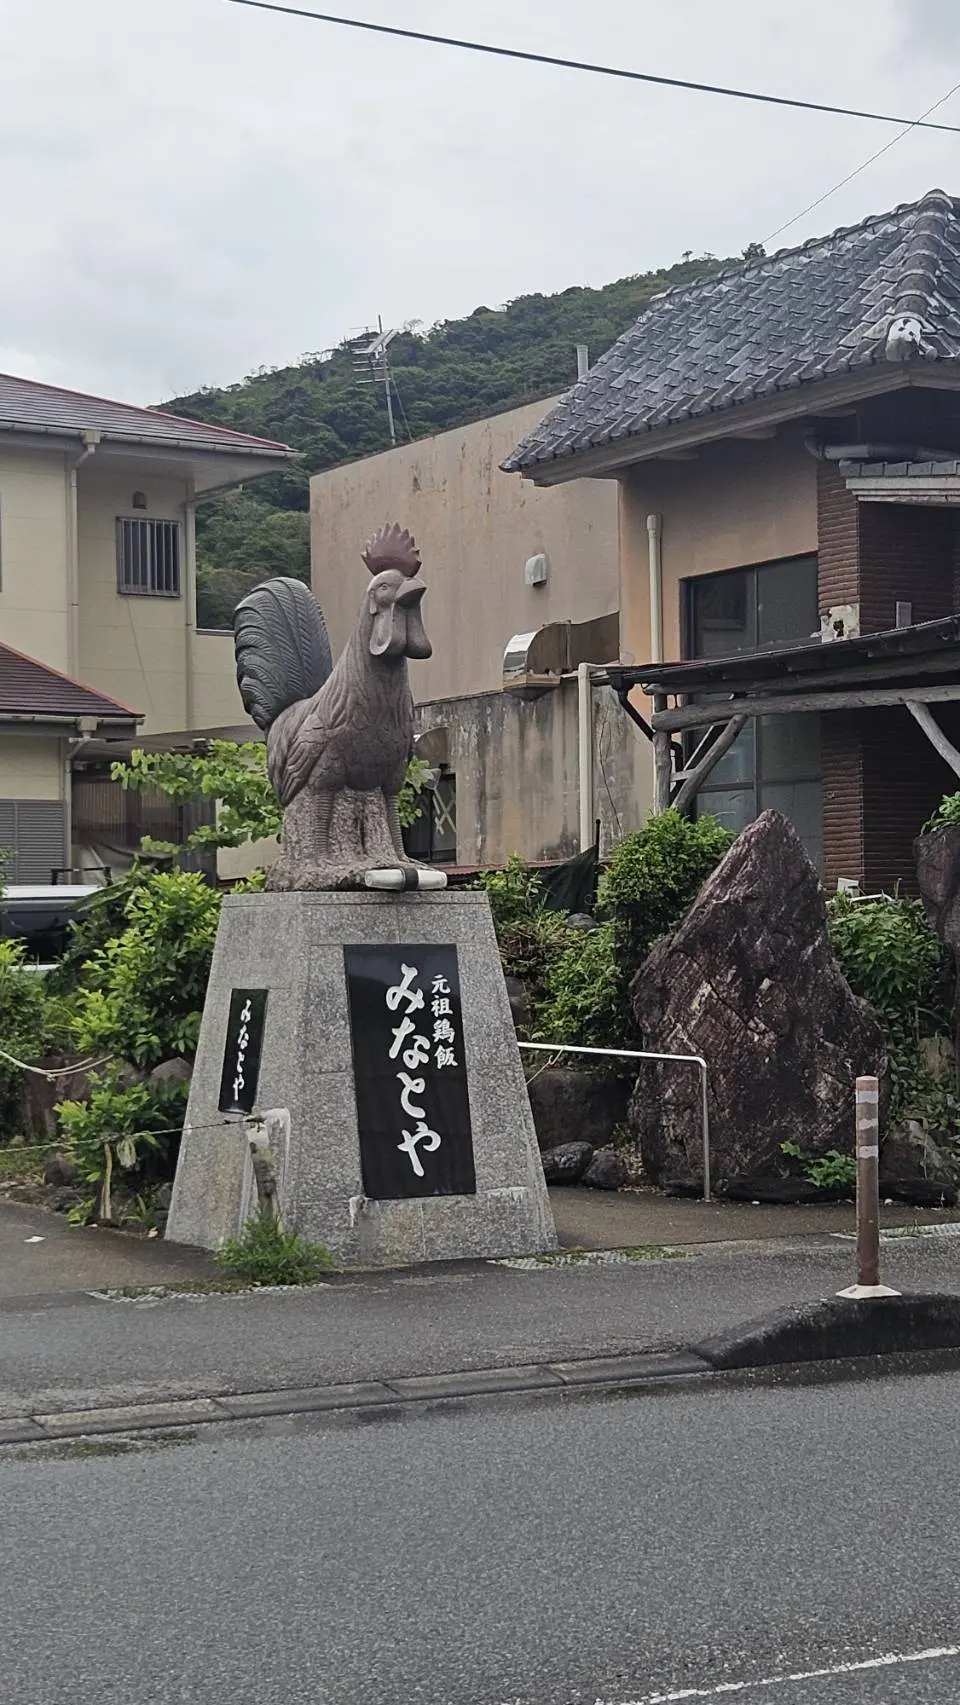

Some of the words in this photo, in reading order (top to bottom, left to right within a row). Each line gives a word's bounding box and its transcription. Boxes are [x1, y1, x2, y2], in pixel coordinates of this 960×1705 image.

[233, 999, 251, 1101] みなとや
[386, 963, 441, 1177] みなとや
[431, 974, 458, 1069] 元祖鶏飯
